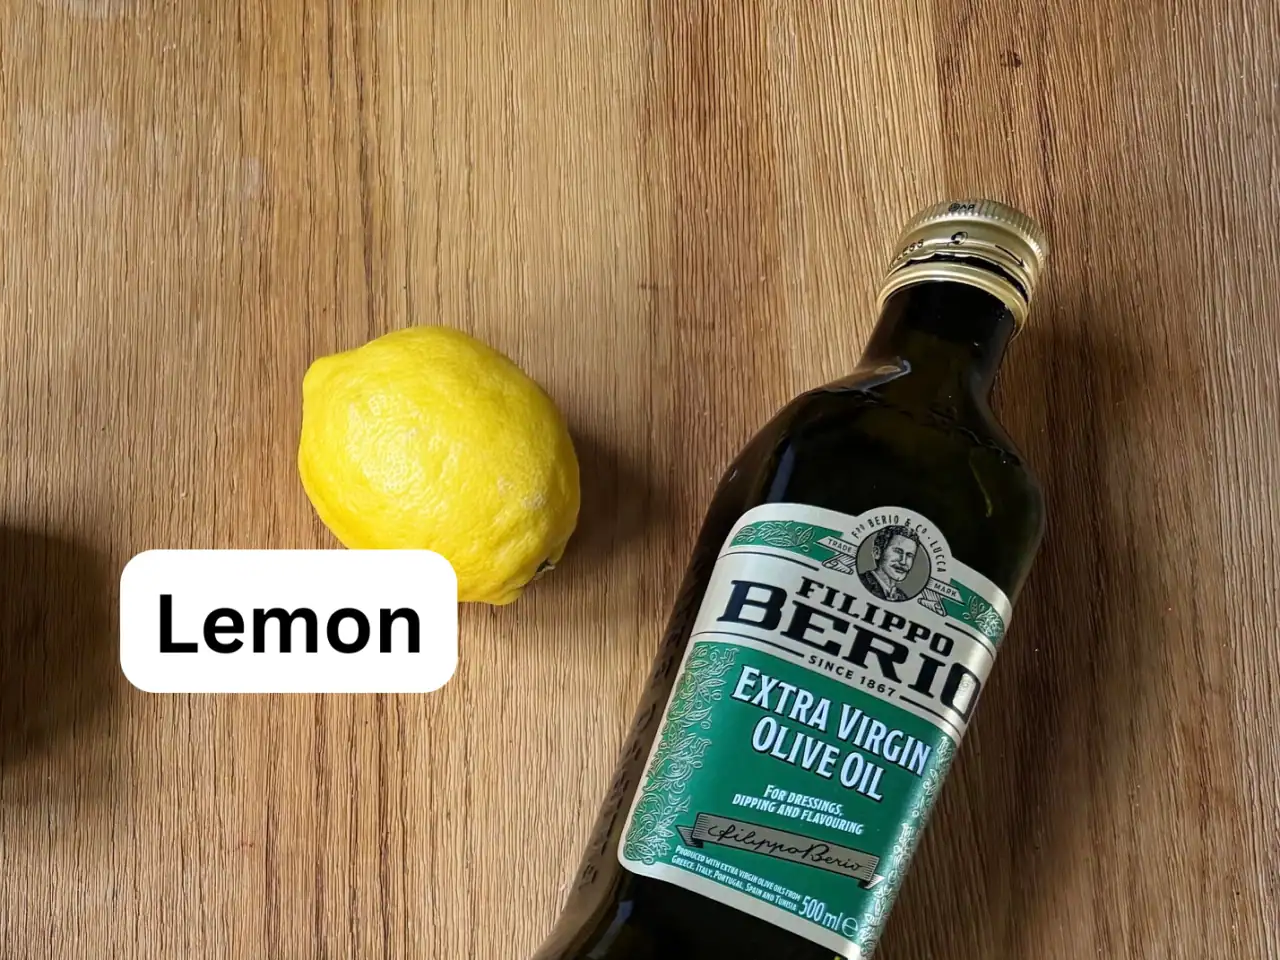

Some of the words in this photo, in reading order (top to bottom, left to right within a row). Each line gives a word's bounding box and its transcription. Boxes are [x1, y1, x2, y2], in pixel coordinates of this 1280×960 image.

[827, 538, 853, 553] TRADE
[867, 514, 900, 528] BERIO
[904, 518, 912, 527] &
[930, 540, 947, 573] LUCCA
[933, 582, 957, 598] MARK
[795, 576, 955, 658] FILIPPO
[716, 579, 981, 724] BERIO
[808, 655, 854, 680] SINCE
[860, 675, 897, 698] 1867
[730, 665, 832, 733] EXTRA
[837, 702, 932, 778] VIRGIN
[752, 716, 841, 780] OLIVE
[840, 751, 887, 802] OIL
[732, 793, 778, 814] DIPPING
[777, 804, 801, 820] AND
[800, 809, 864, 836] FLAVOURING
[763, 784, 788, 801] FOR
[786, 792, 845, 818] DRESSINGS,
[671, 855, 695, 870] GREECE,
[695, 863, 713, 878] ITALY,
[744, 883, 763, 896] SPAIN
[762, 891, 775, 902] AND
[675, 845, 706, 862] PRODUCED
[704, 855, 721, 868] WITH
[720, 864, 739, 876] EXTRA
[739, 869, 758, 883] VIRGIN
[757, 878, 774, 890] OLIVE
[773, 883, 786, 895] OILS
[785, 889, 801, 901] FROM
[801, 843, 865, 871] Berio
[798, 895, 826, 921] 500
